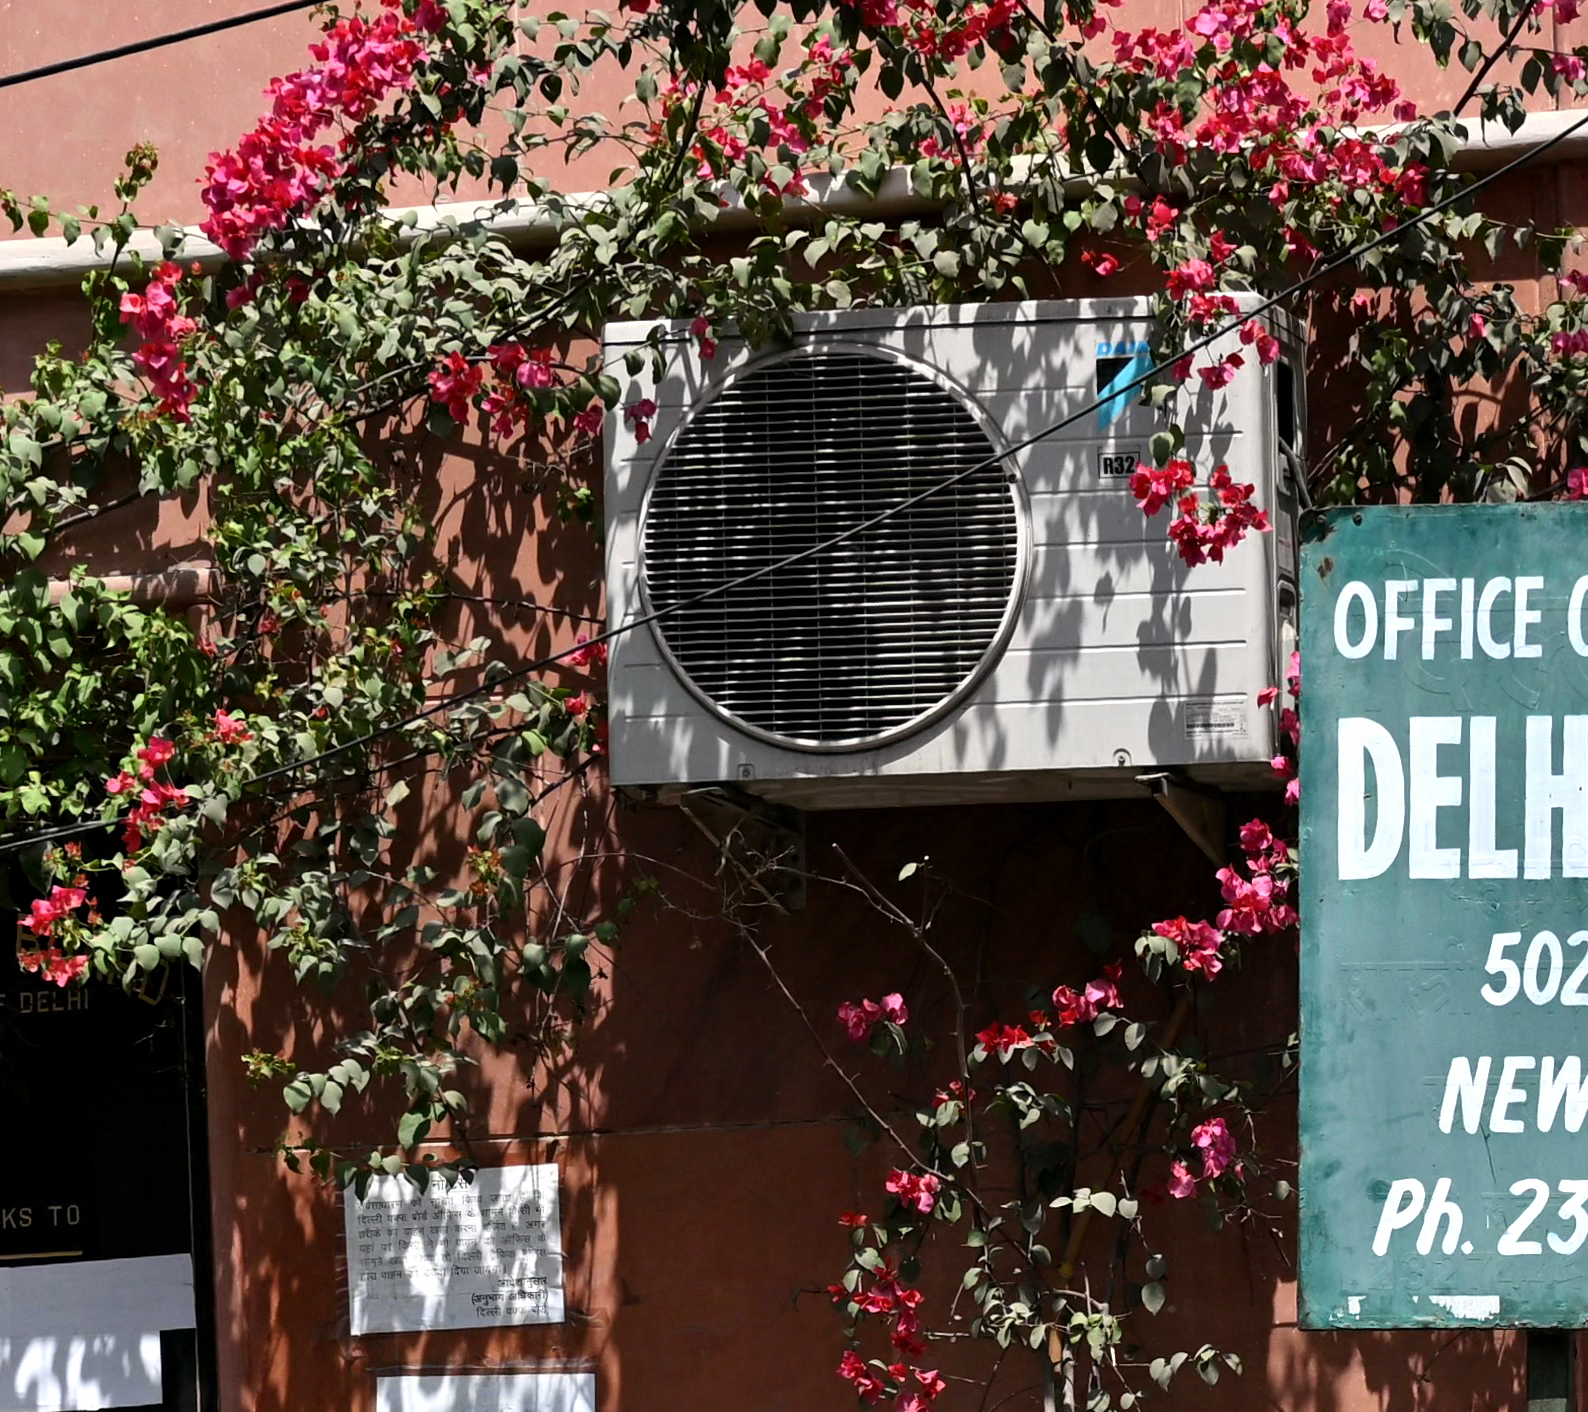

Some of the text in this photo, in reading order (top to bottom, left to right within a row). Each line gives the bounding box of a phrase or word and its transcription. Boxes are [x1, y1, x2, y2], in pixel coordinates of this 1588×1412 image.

[1103, 456, 1135, 474] R32
[1334, 576, 1544, 660] OFFICE
[20, 988, 90, 1014] DELHI
[48, 1204, 81, 1226] TO
[1372, 1176, 1475, 1257] Ph.
